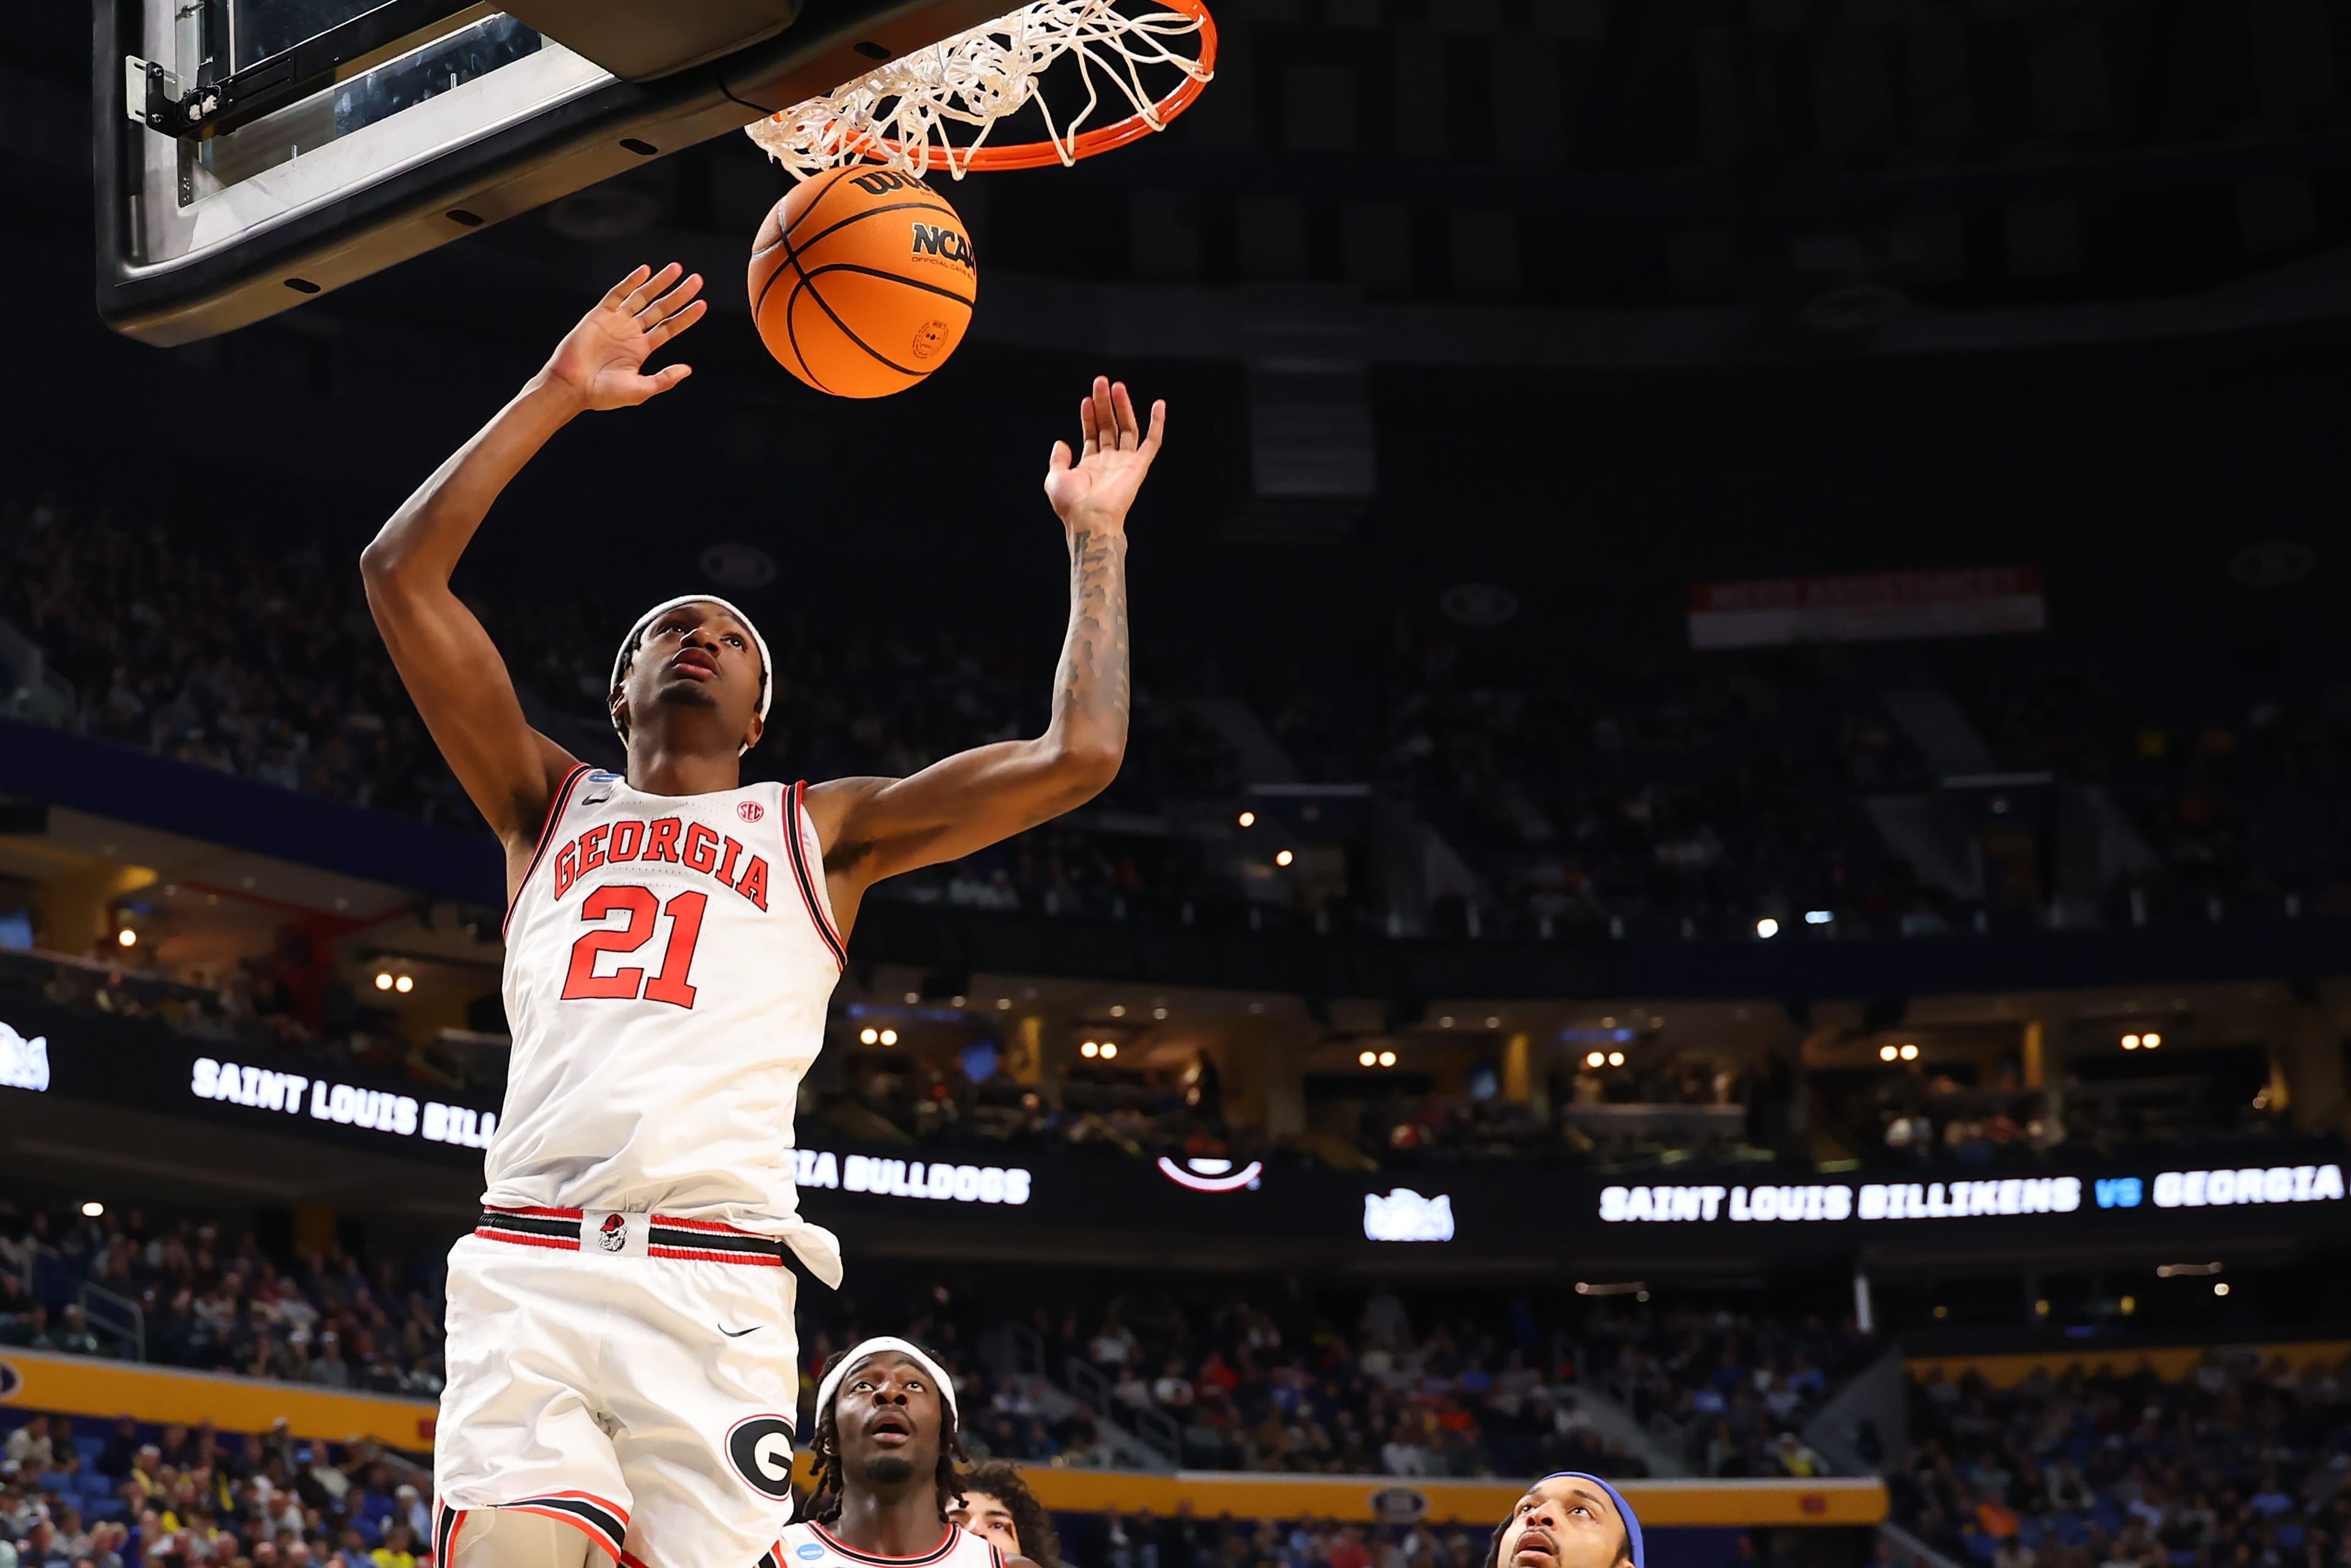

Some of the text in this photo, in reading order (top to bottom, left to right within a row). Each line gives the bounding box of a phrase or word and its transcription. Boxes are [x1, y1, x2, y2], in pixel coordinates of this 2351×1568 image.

[740, 803, 761, 820] SEC
[553, 817, 768, 913] GEORGIA
[560, 885, 708, 1010] 21
[192, 1057, 497, 1150] SAINT LOUIS BILL
[843, 1154, 1032, 1205] BULLDOGS
[1599, 1164, 2345, 1222] SAINT LOUIS BILLIKENS VS GEORGIA
[730, 1418, 795, 1496] G
